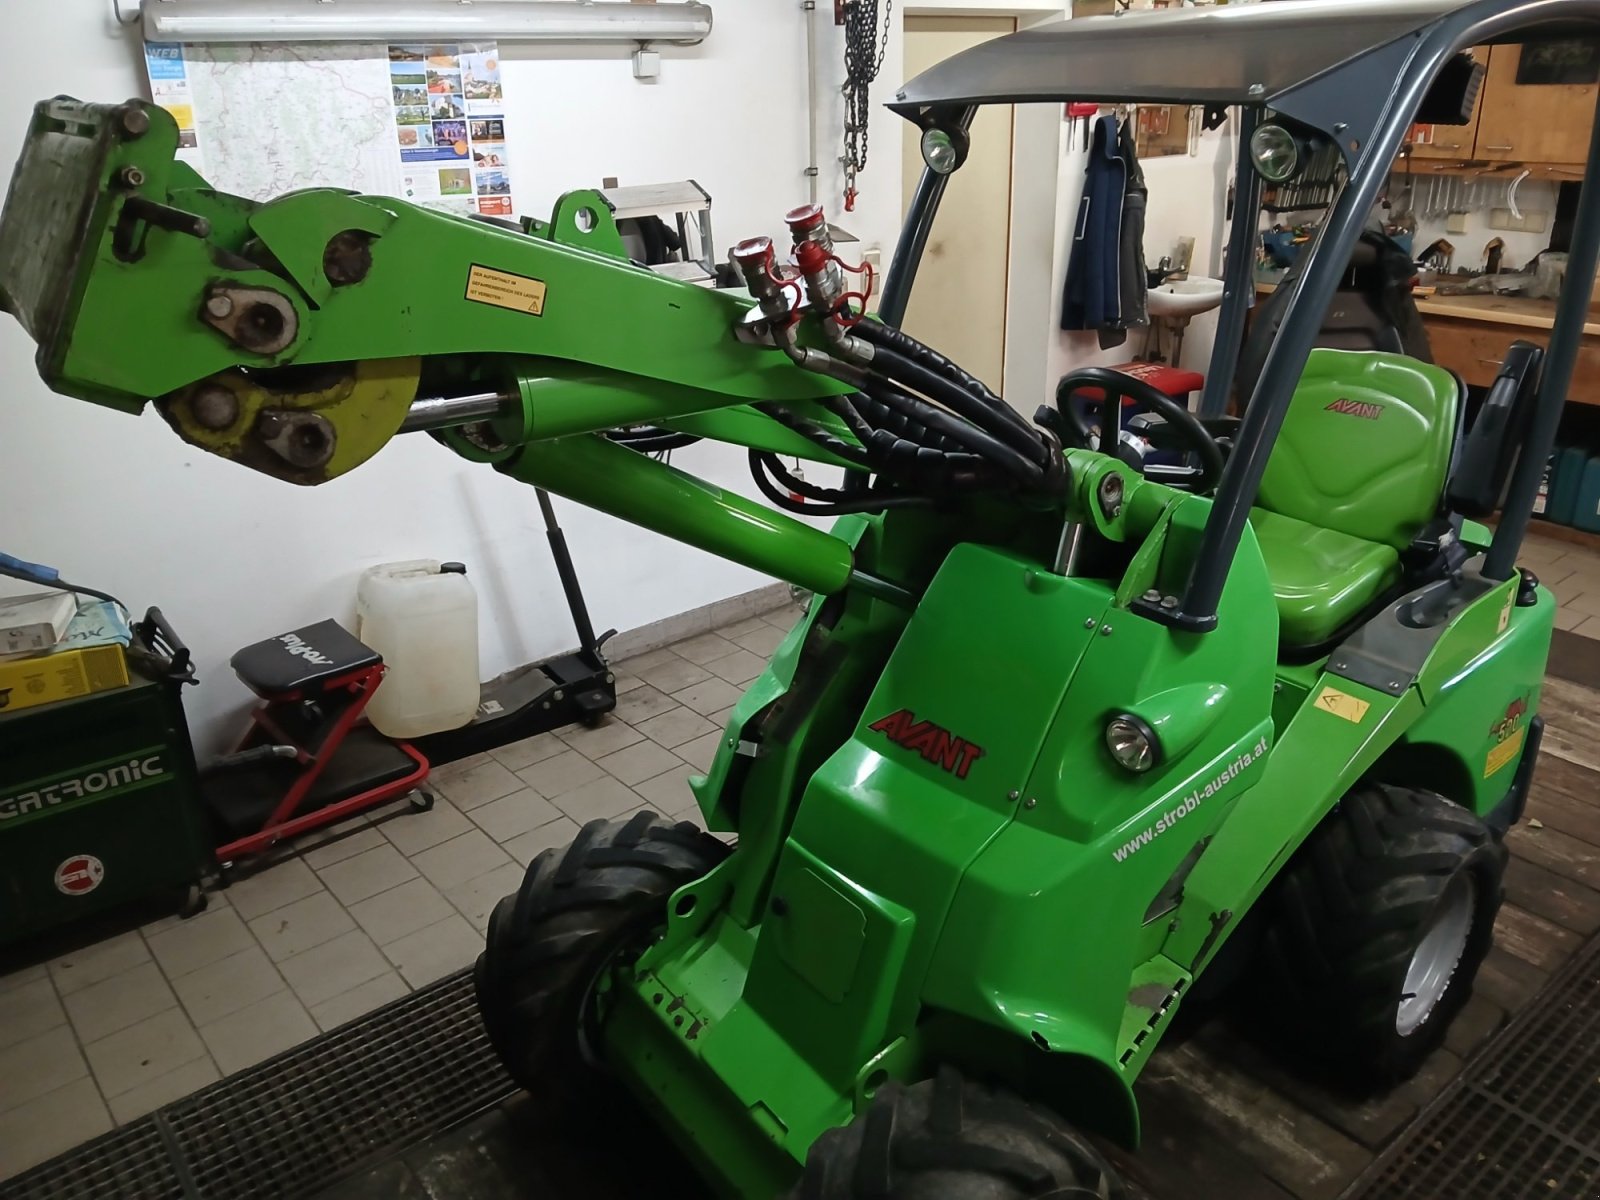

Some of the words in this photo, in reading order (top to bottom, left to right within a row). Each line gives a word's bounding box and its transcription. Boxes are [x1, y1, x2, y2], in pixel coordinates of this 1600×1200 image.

[483, 274, 510, 284] AUFENTHALT
[1323, 398, 1385, 420] AVANT
[867, 708, 985, 780] AVANT
[1112, 735, 1269, 863] www.strobl-austria.at
